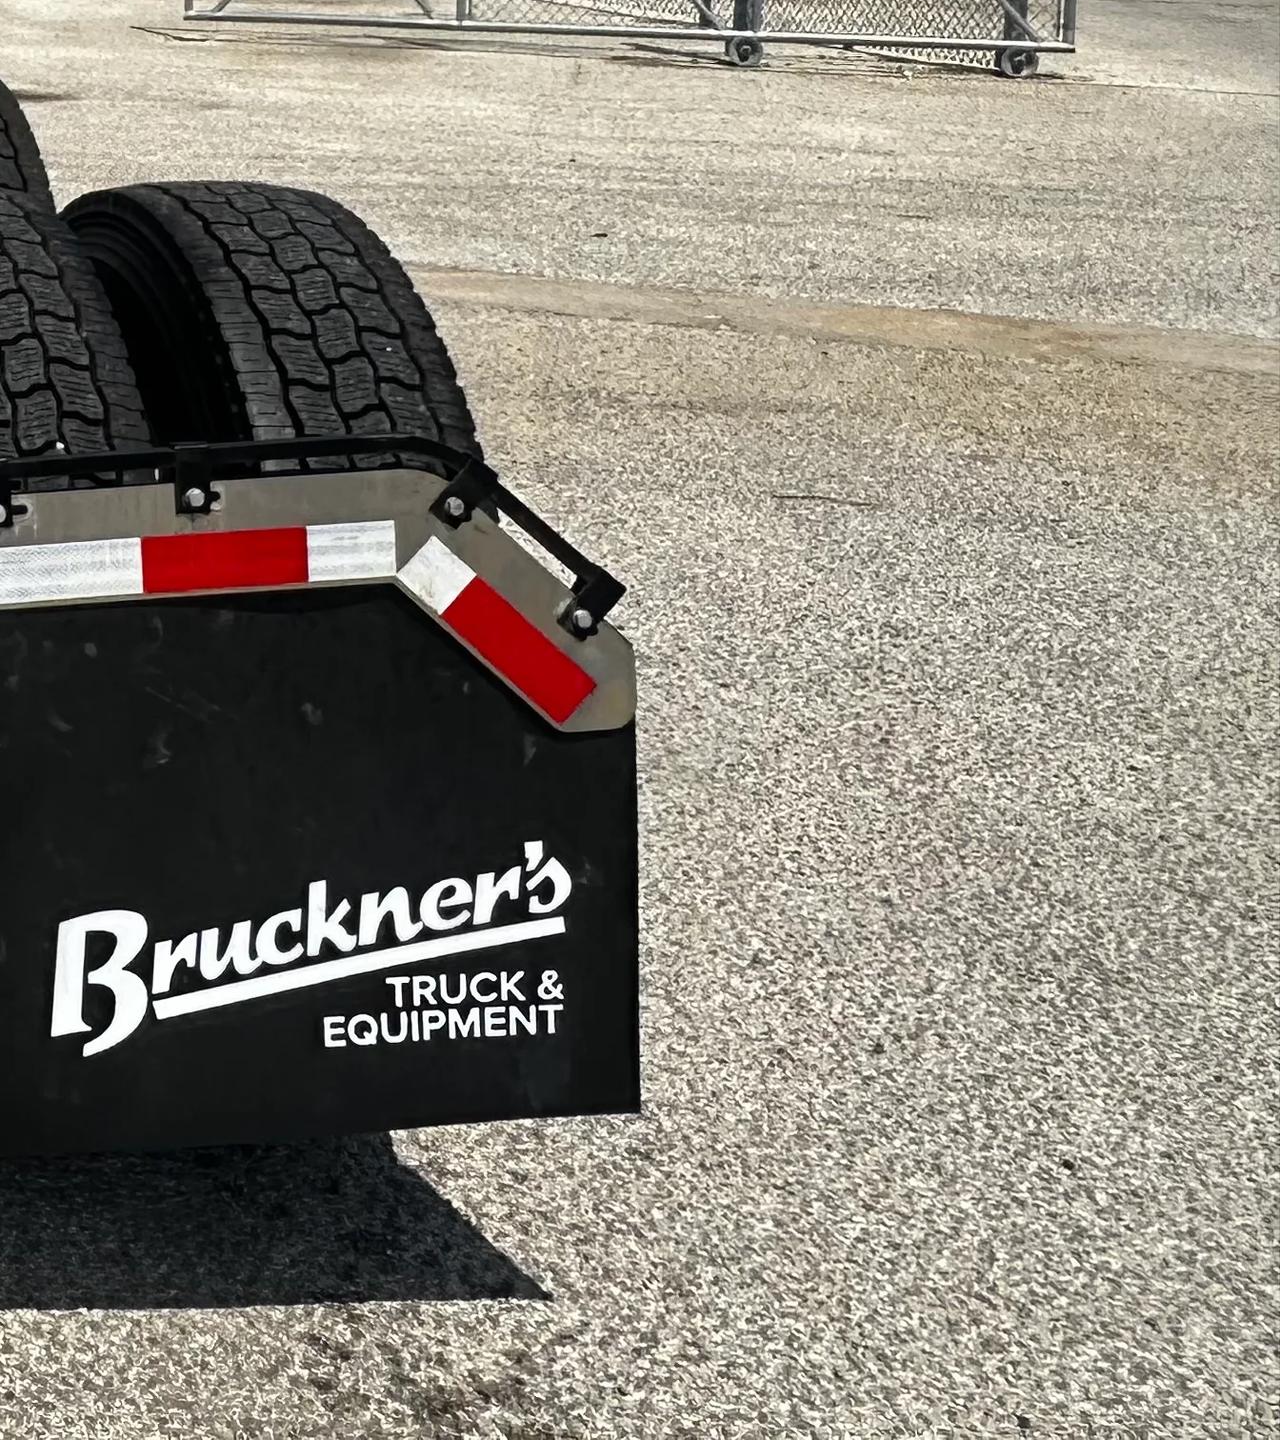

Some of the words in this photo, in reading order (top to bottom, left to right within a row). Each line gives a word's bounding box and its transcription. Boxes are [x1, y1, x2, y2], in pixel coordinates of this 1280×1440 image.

[51, 840, 573, 1058] Bruckner's
[385, 970, 525, 1008] TRUCK
[537, 969, 565, 1001] &
[323, 1003, 564, 1049] EQUIPMENT
